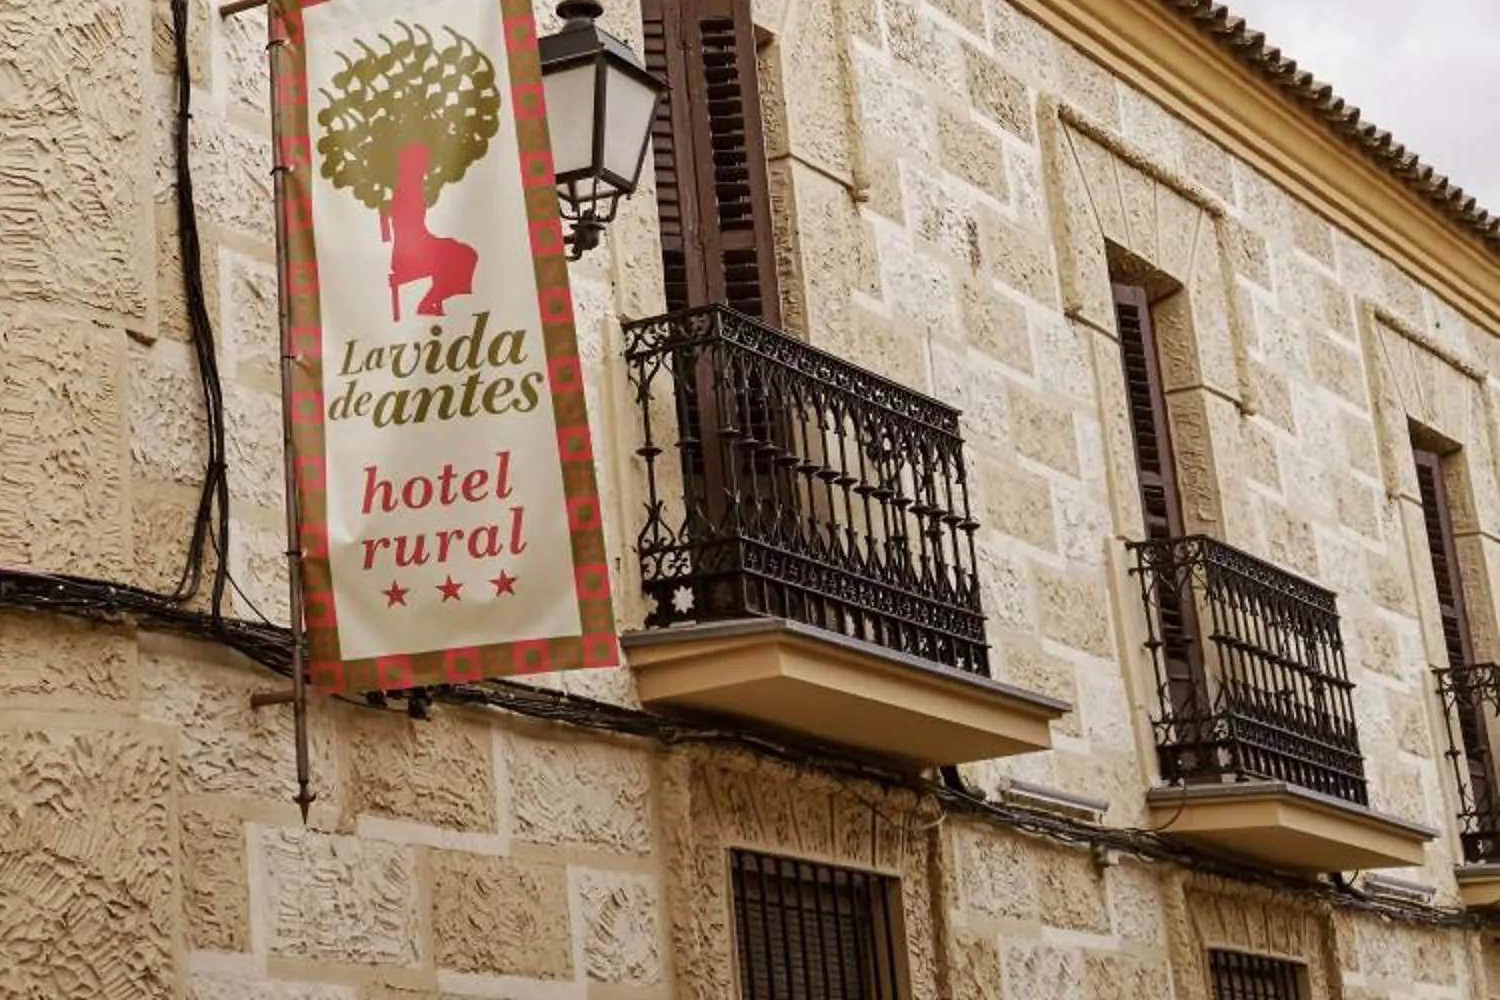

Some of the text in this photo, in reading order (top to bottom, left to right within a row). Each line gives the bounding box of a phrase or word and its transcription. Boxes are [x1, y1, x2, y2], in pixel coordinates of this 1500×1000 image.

[389, 311, 528, 379] vida
[373, 370, 545, 428] antes
[362, 450, 513, 514] hotel
[361, 506, 528, 570] rural
